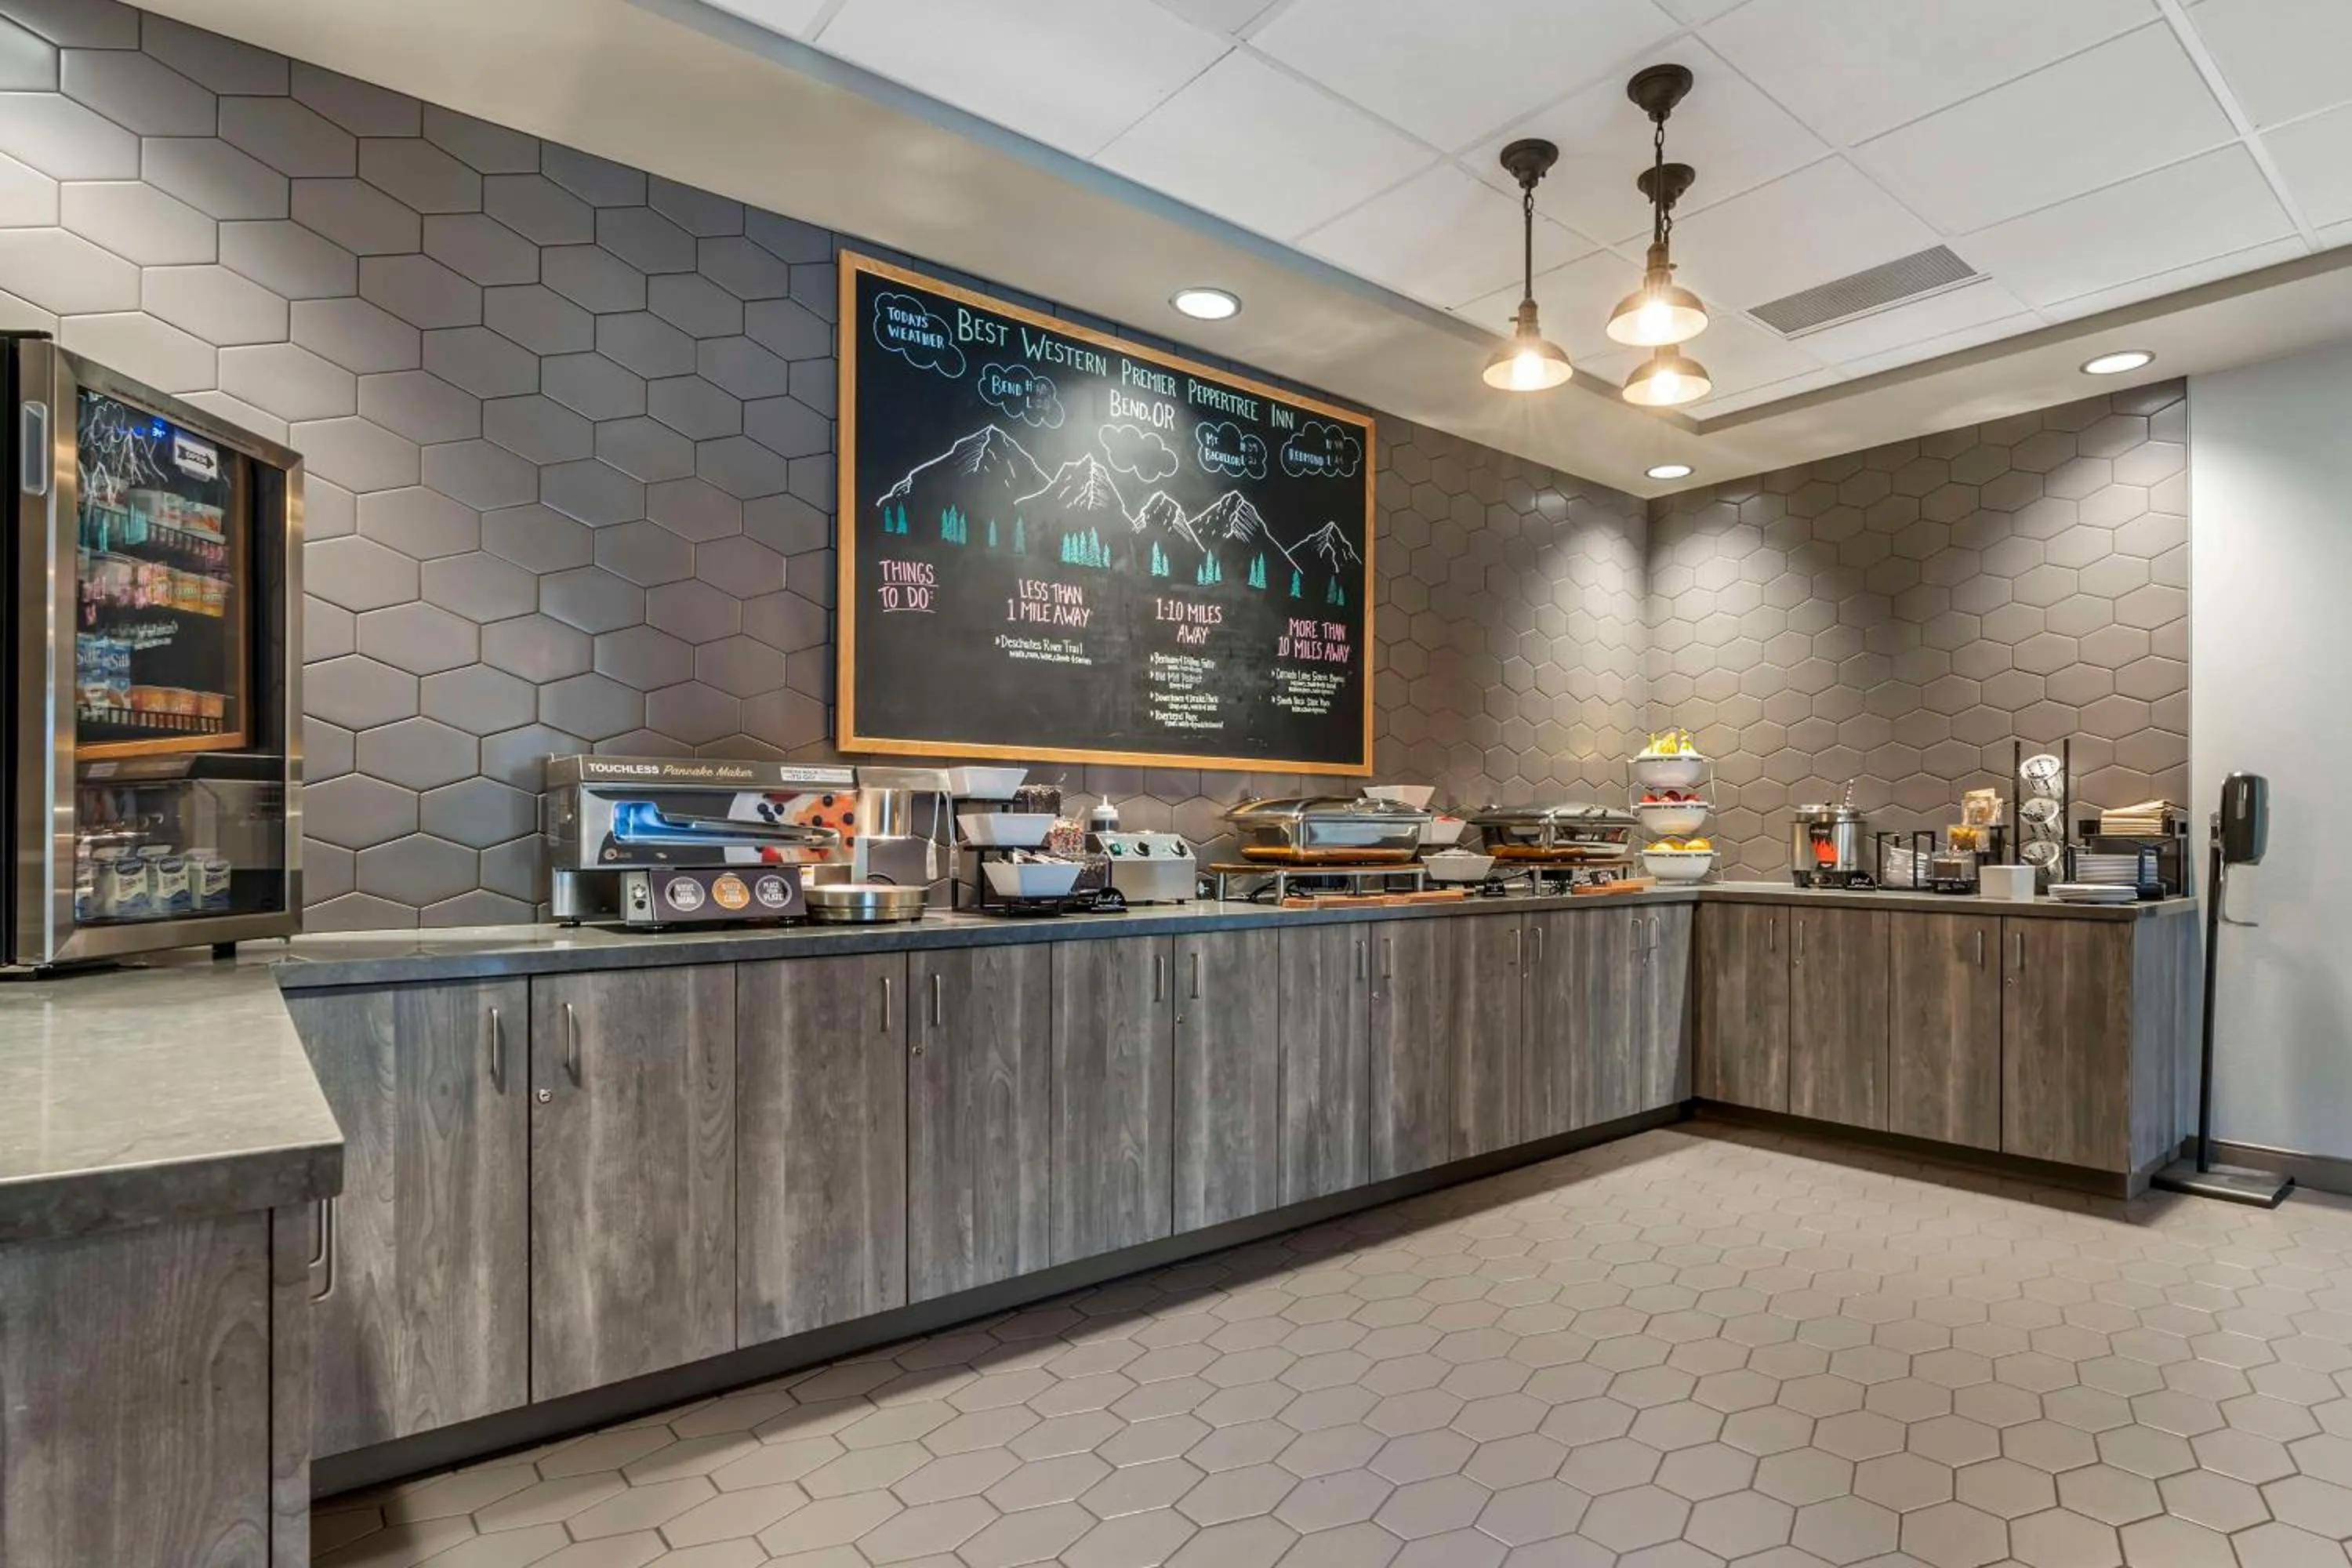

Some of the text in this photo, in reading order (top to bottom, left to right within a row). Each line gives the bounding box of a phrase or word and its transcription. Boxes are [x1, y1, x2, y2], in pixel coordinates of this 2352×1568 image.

[887, 307, 929, 328] TODAYS
[887, 324, 945, 350] WEATHER
[957, 307, 1294, 430] BEST WESTERN PREMIER PEPPERTREE INN
[992, 375, 1023, 397] BEND
[878, 559, 935, 585] THINGS
[877, 586, 898, 608] TO
[1018, 578, 1083, 606] LESS THAN
[1006, 597, 1017, 622] 1
[1020, 601, 1051, 622] MILE
[1155, 597, 1223, 625] 1-10 MILES
[1288, 616, 1347, 642] MORE THAN
[1276, 636, 1290, 657] 10
[1294, 638, 1323, 660] MILES
[589, 763, 753, 779] TOUCHLESS Pancake Maker
